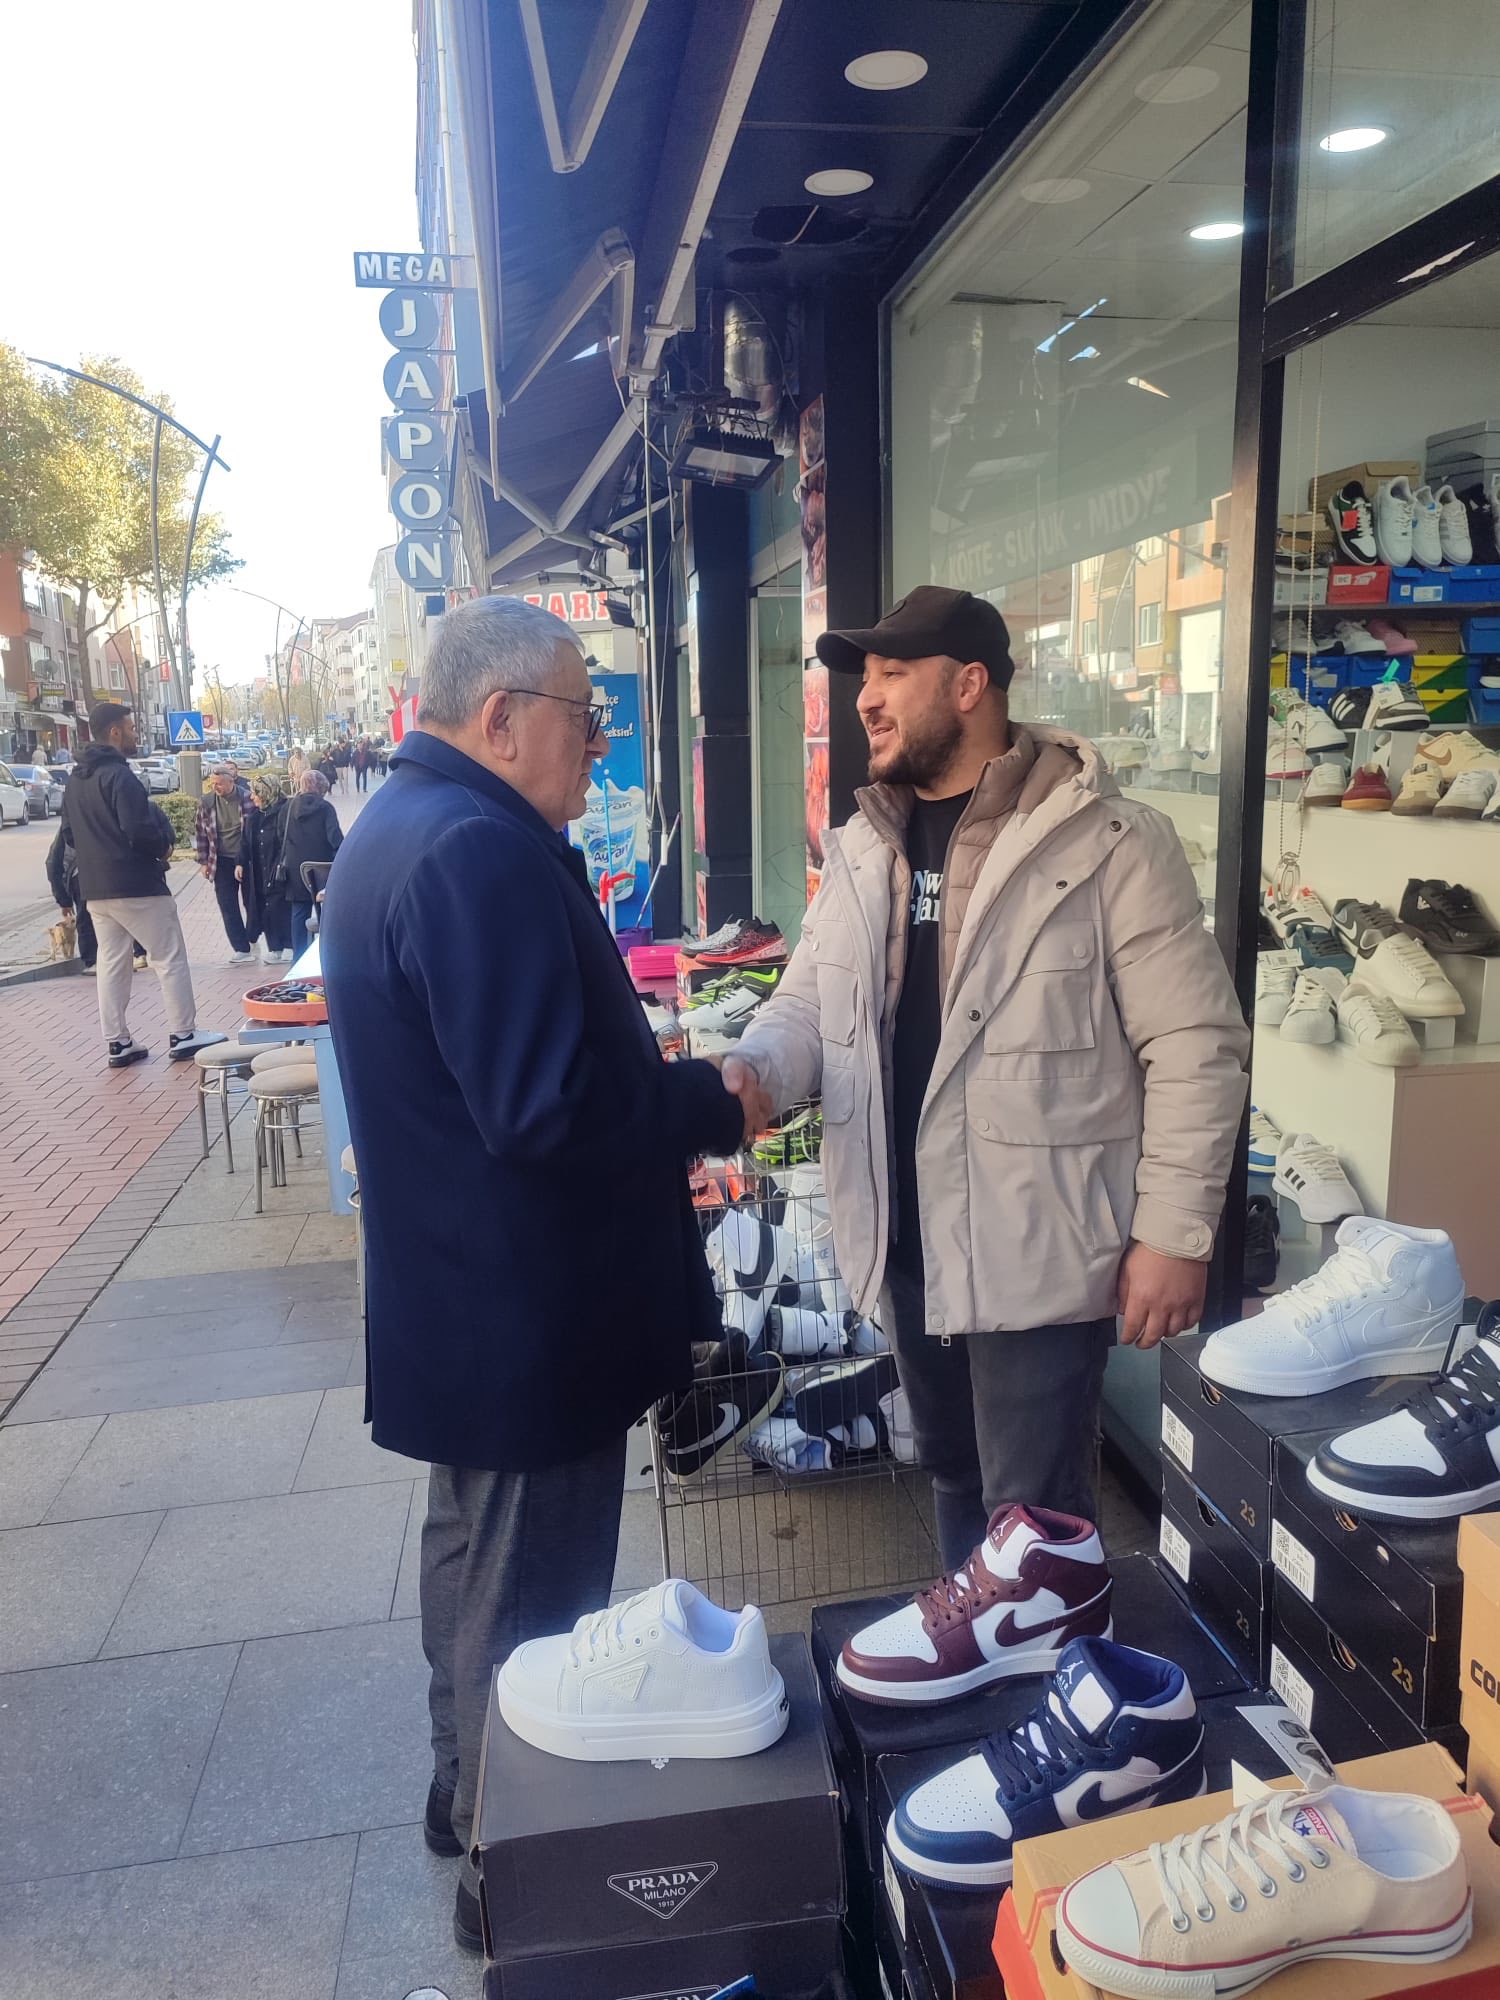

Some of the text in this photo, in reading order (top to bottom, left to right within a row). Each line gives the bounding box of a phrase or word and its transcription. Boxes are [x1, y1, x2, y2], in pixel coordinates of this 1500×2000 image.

[359, 254, 447, 283] MEGA
[394, 299, 442, 579] JAPON
[1239, 1499, 1256, 1528] 23
[1235, 1609, 1250, 1639] 23
[1391, 1657, 1413, 1694] 23
[628, 1871, 700, 1891] PRADA
[644, 1887, 686, 1901] MILANO
[658, 1900, 675, 1908] 1913
